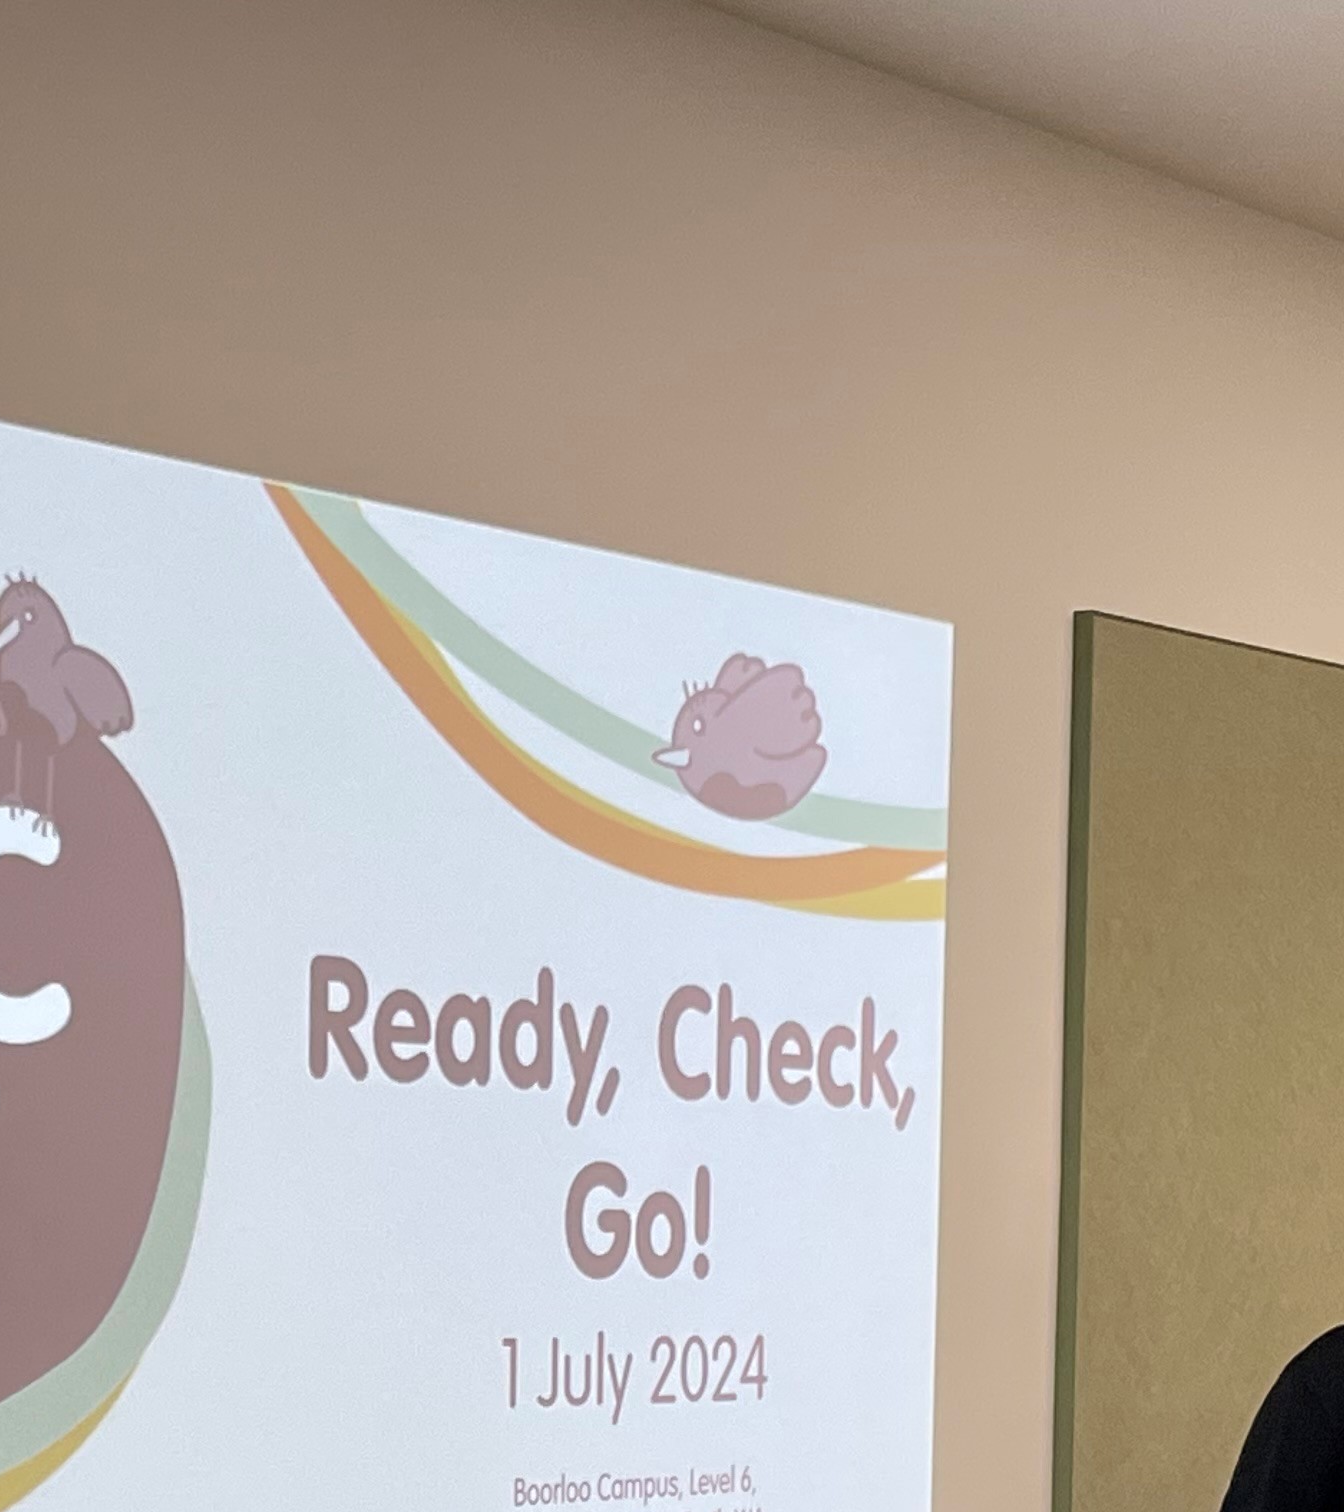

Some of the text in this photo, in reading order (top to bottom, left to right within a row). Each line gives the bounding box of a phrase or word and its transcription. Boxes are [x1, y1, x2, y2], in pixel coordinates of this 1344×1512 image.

[309, 955, 916, 1131] Ready, Check,
[565, 1161, 711, 1280] Go!
[502, 1331, 768, 1425] 1 July 2024
[514, 1464, 756, 1507] Boorloo Campus, Level 6,
